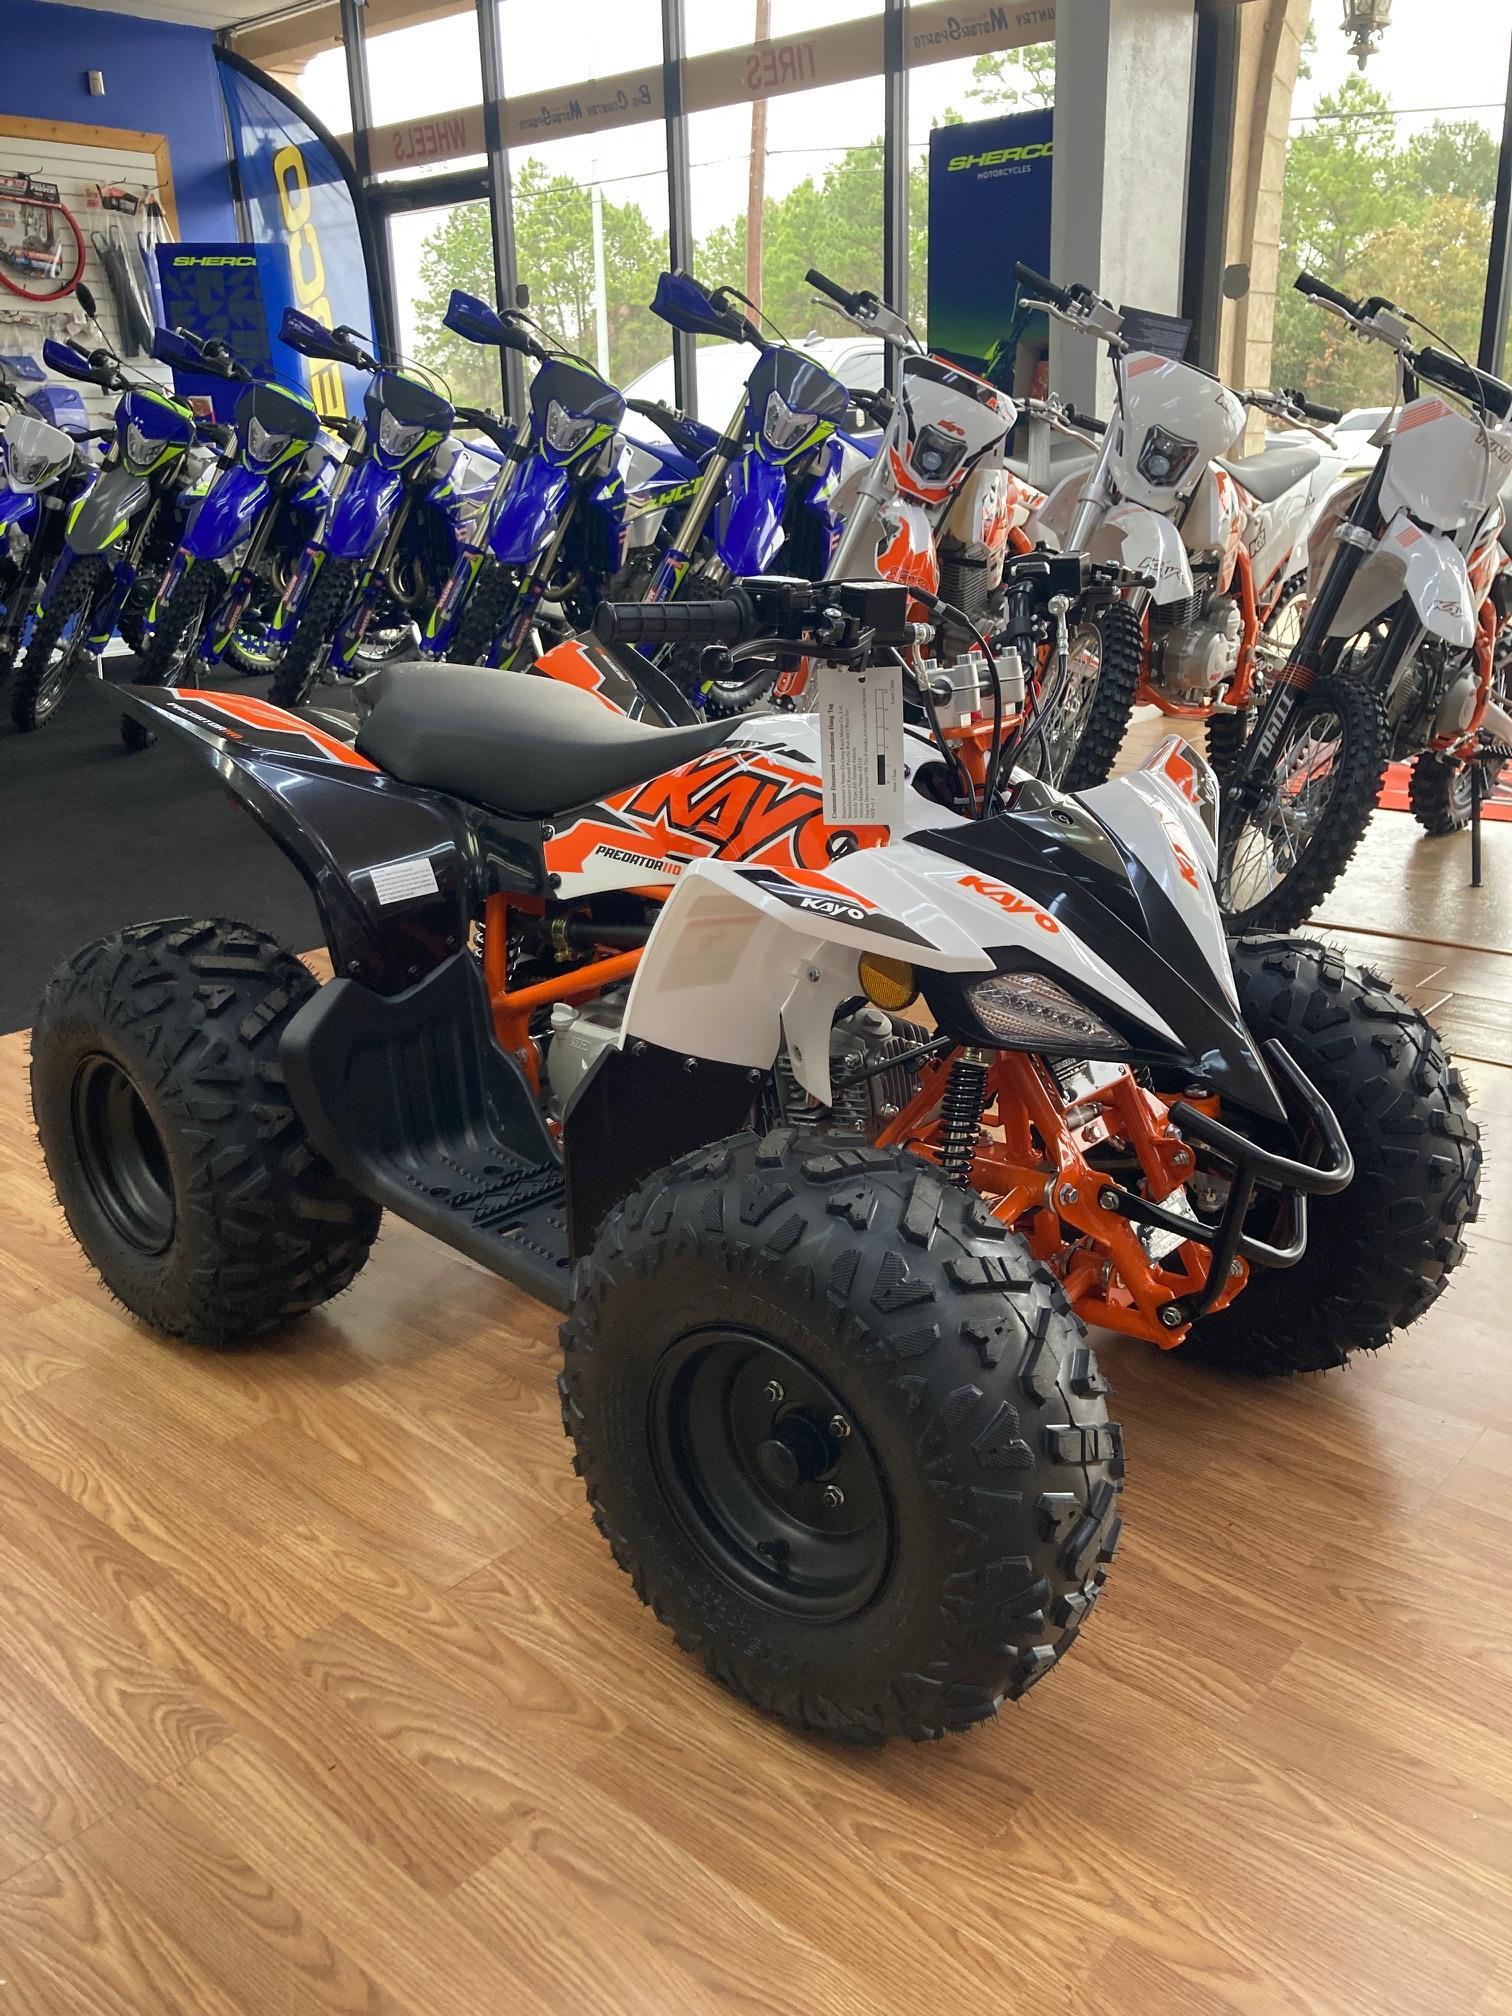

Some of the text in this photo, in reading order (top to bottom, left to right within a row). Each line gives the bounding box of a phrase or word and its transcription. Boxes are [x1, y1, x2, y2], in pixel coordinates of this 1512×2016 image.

[977, 165, 1032, 180] MOTORCYCLES
[800, 895, 865, 920] KAYO
[956, 874, 1060, 934] KAYO
